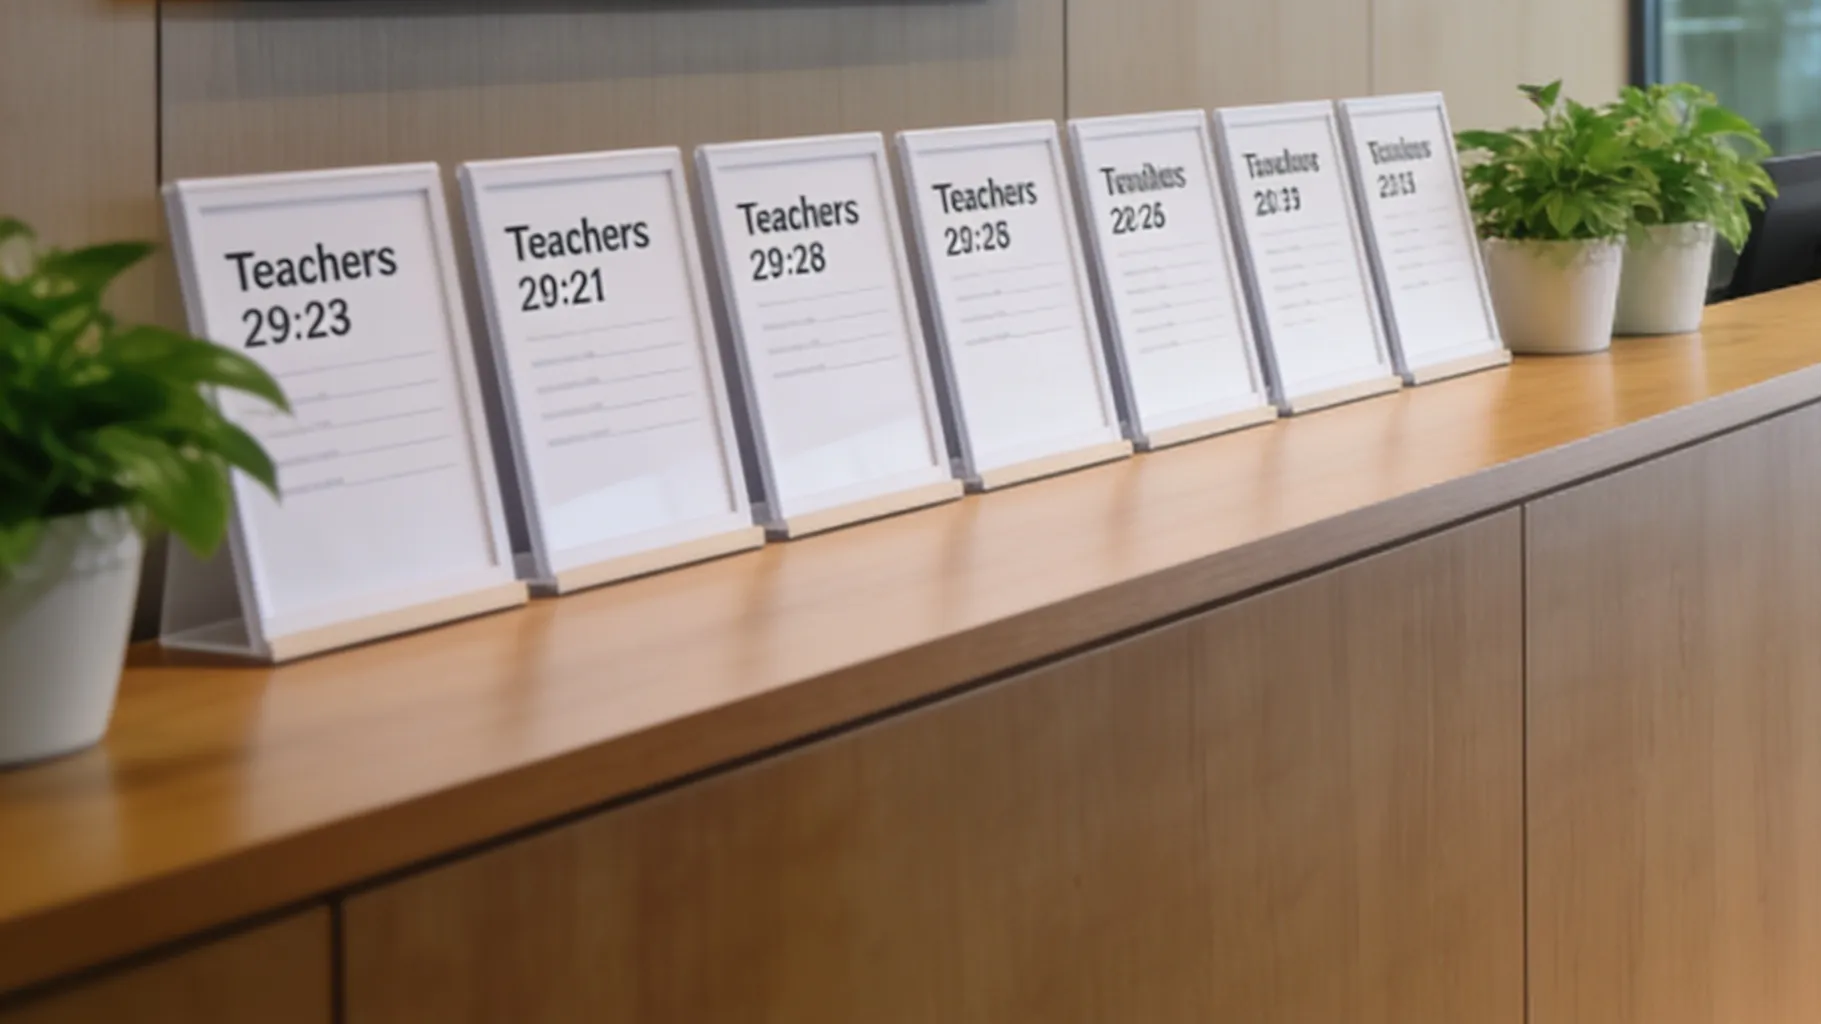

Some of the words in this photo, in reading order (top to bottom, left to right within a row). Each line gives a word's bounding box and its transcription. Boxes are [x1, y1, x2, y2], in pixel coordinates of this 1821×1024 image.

[737, 194, 860, 236] Teachers
[932, 177, 1038, 214] Teachers
[506, 216, 651, 263] Teachers
[750, 240, 827, 281] 29:28
[226, 242, 398, 292] Teachers
[518, 268, 606, 312] 29:21
[242, 298, 352, 348] 29:23
